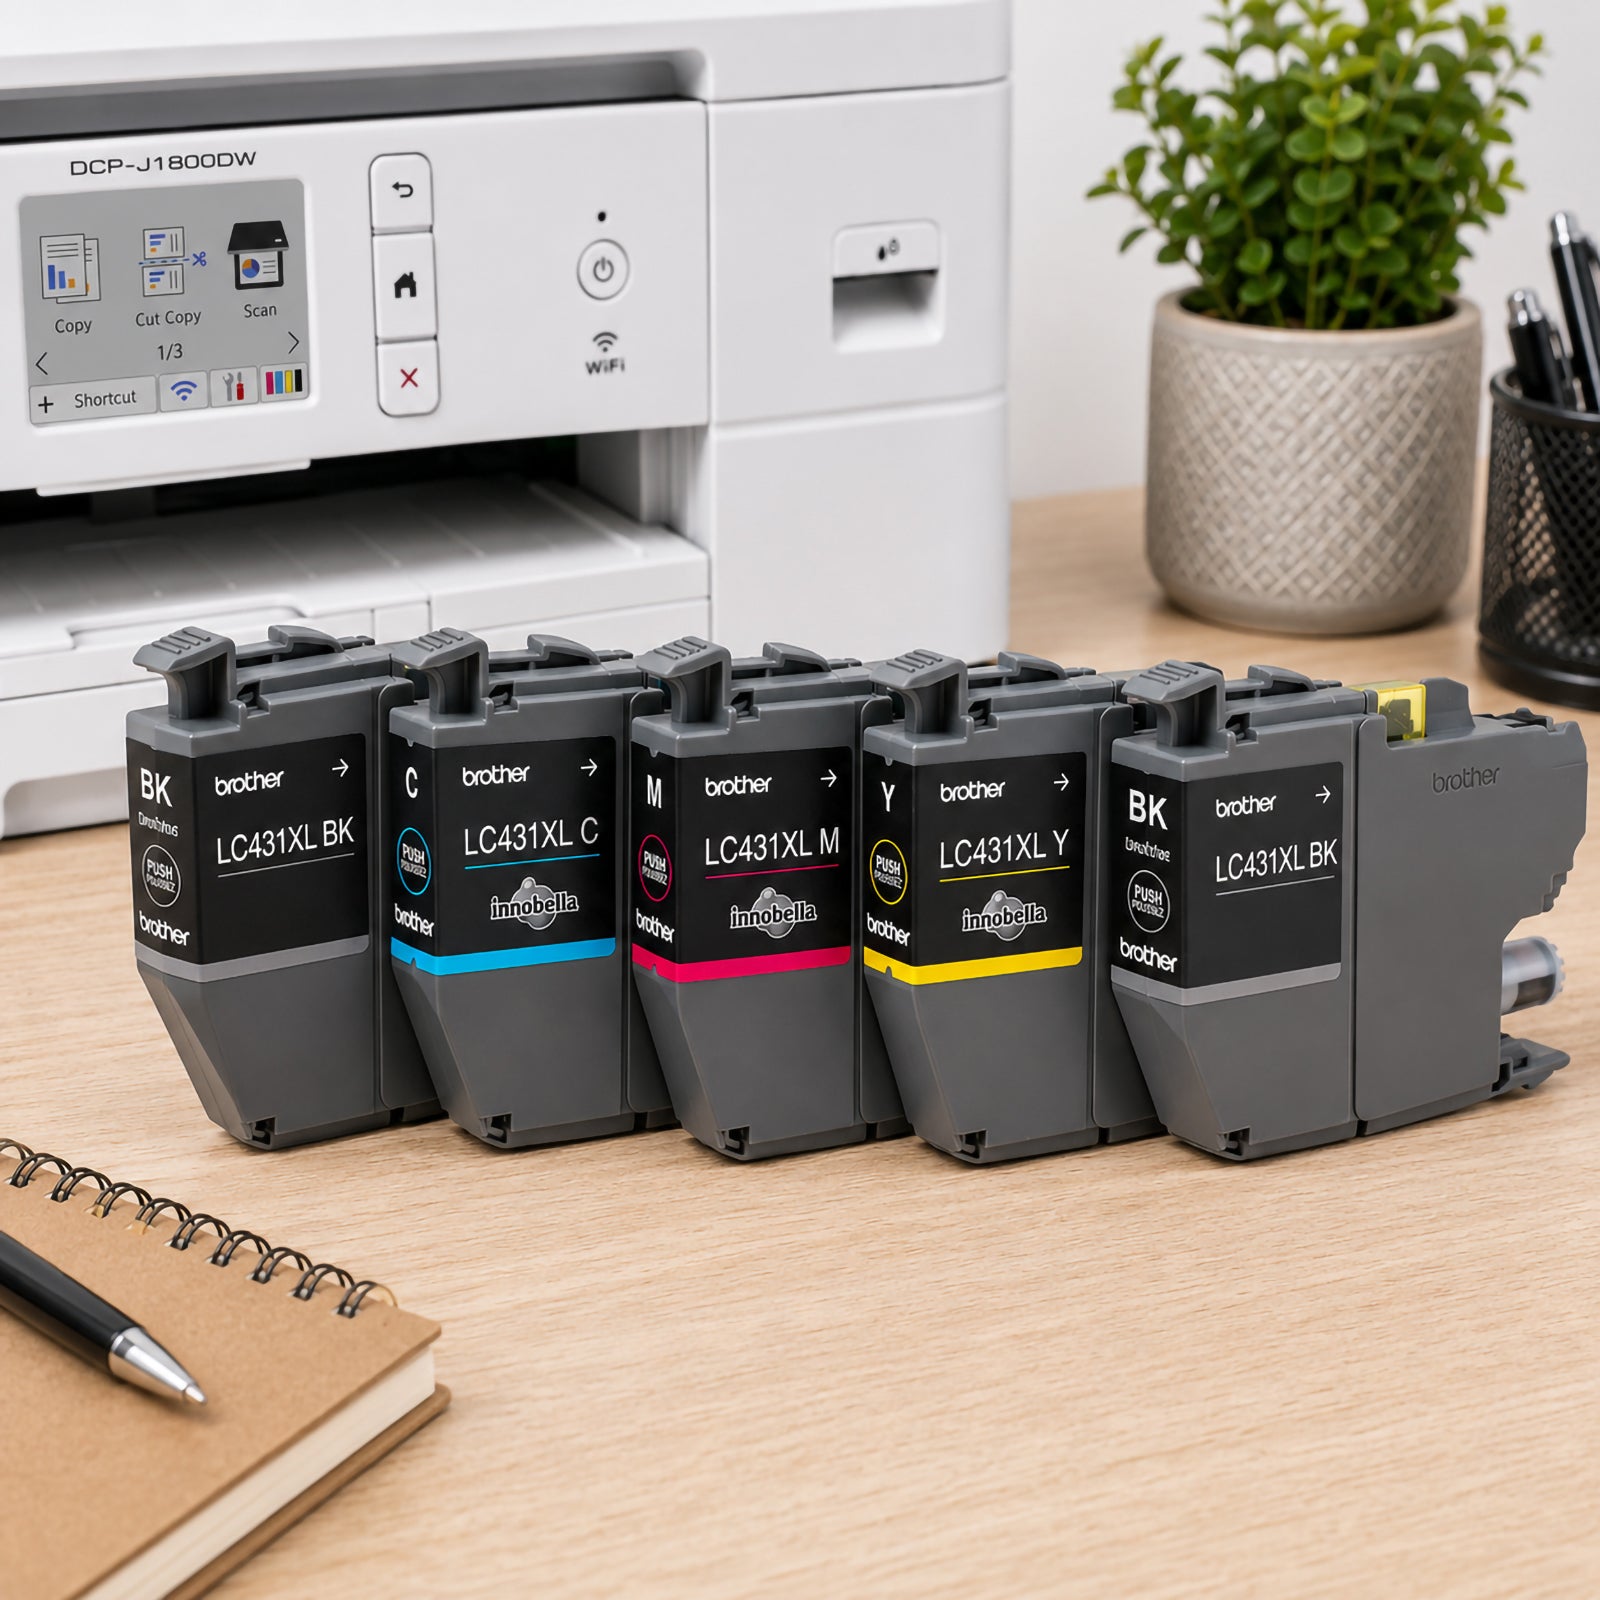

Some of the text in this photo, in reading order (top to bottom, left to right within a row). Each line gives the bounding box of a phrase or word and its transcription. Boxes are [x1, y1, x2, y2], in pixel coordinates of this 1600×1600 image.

[70, 151, 257, 176] DCP-J1800DW
[135, 310, 202, 327] Cut Copy
[244, 303, 277, 318] Scan
[55, 318, 92, 335] Copy
[157, 343, 183, 360] 1/3
[585, 358, 626, 375] WiFi
[74, 390, 137, 408] Shortcut
[140, 767, 173, 807] BK
[215, 770, 284, 796] brother
[405, 766, 419, 799] C
[462, 764, 530, 787] brother
[705, 775, 772, 797] brother
[1432, 766, 1500, 794] brother
[647, 774, 662, 809] M
[880, 781, 895, 812] Y
[940, 781, 1005, 802] brother
[1129, 788, 1168, 830] BK
[1216, 795, 1277, 818] brother
[217, 824, 318, 865] LC431XL
[322, 816, 355, 847] BK
[464, 816, 599, 855] LC431XL C
[705, 827, 839, 865] LC431XL M
[940, 829, 1070, 869] LC431XL Y
[146, 858, 173, 881] PUSH
[875, 854, 901, 876] PUSH
[1216, 839, 1338, 882] LC431XL BK
[490, 891, 579, 921] innobella
[1134, 884, 1163, 906] PUSH
[139, 910, 190, 946] brother
[394, 902, 435, 938] brother
[635, 908, 675, 943] brother
[730, 899, 817, 930] innobella
[962, 903, 1047, 932] innobella
[866, 912, 910, 947] brother
[1119, 936, 1178, 973] brother
